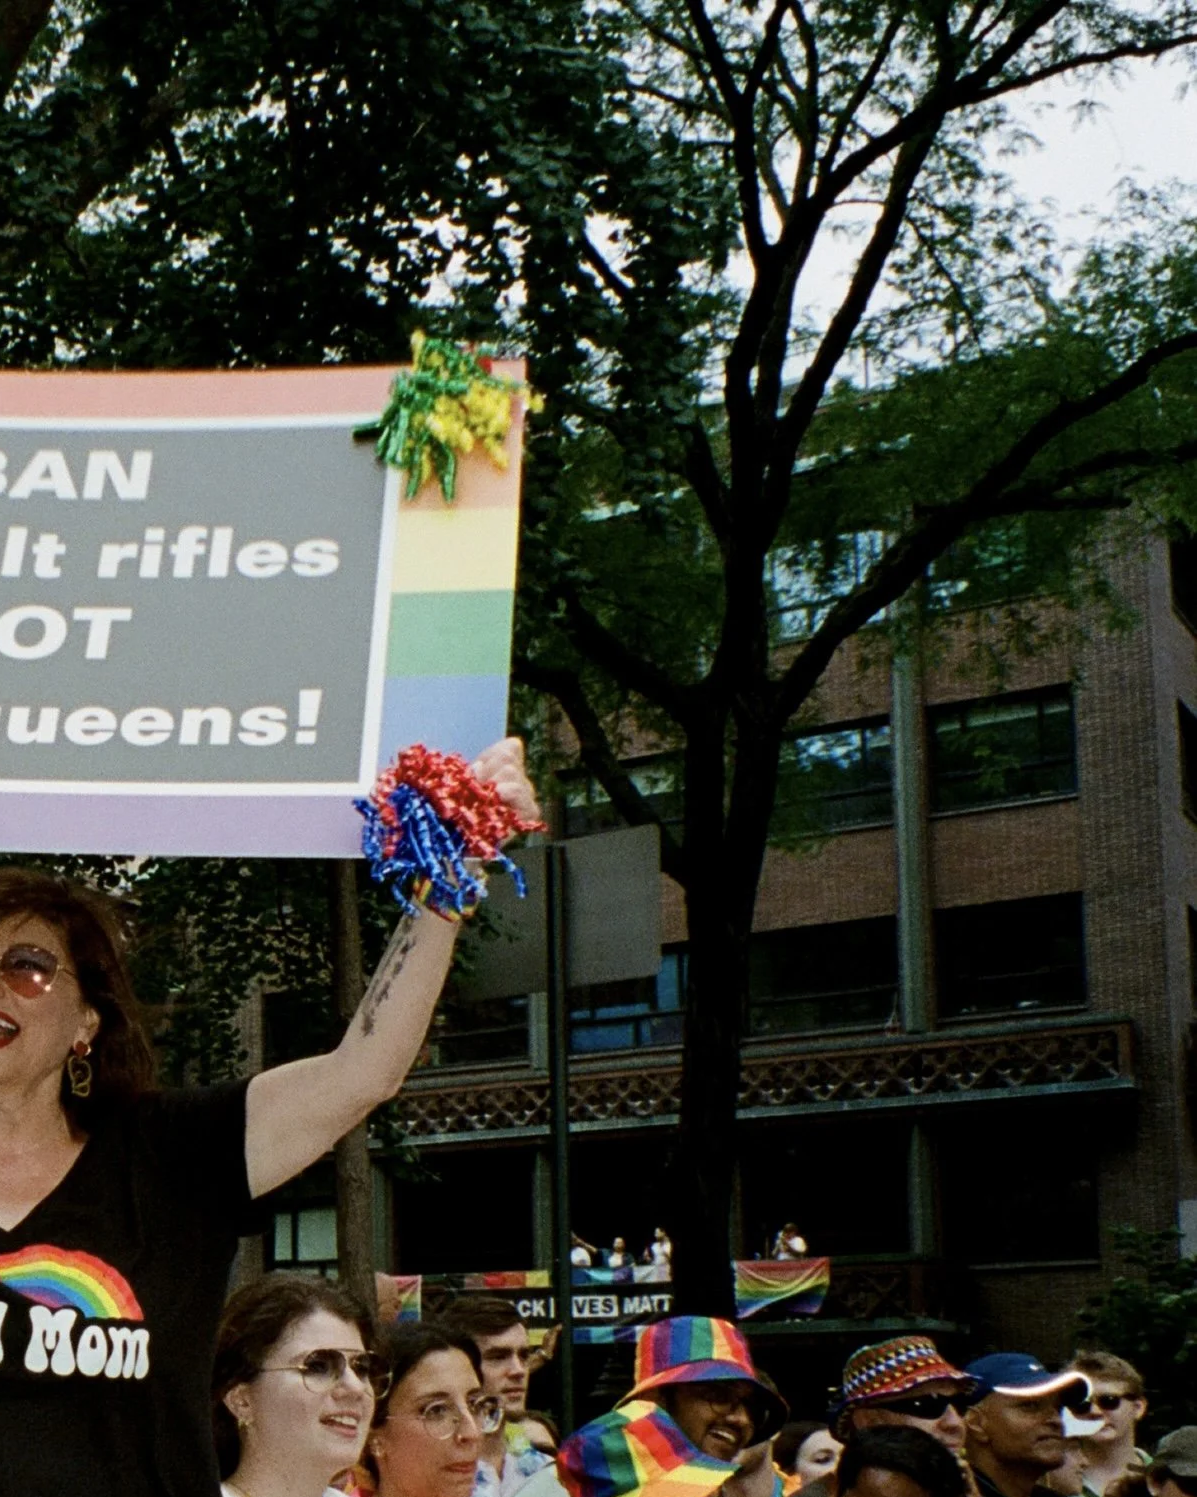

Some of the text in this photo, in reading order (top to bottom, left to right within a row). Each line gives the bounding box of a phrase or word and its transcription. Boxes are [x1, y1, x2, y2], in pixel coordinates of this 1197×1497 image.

[97, 525, 340, 579] rifles
[623, 1294, 673, 1314] MATT
[24, 1305, 150, 1379] Mom
